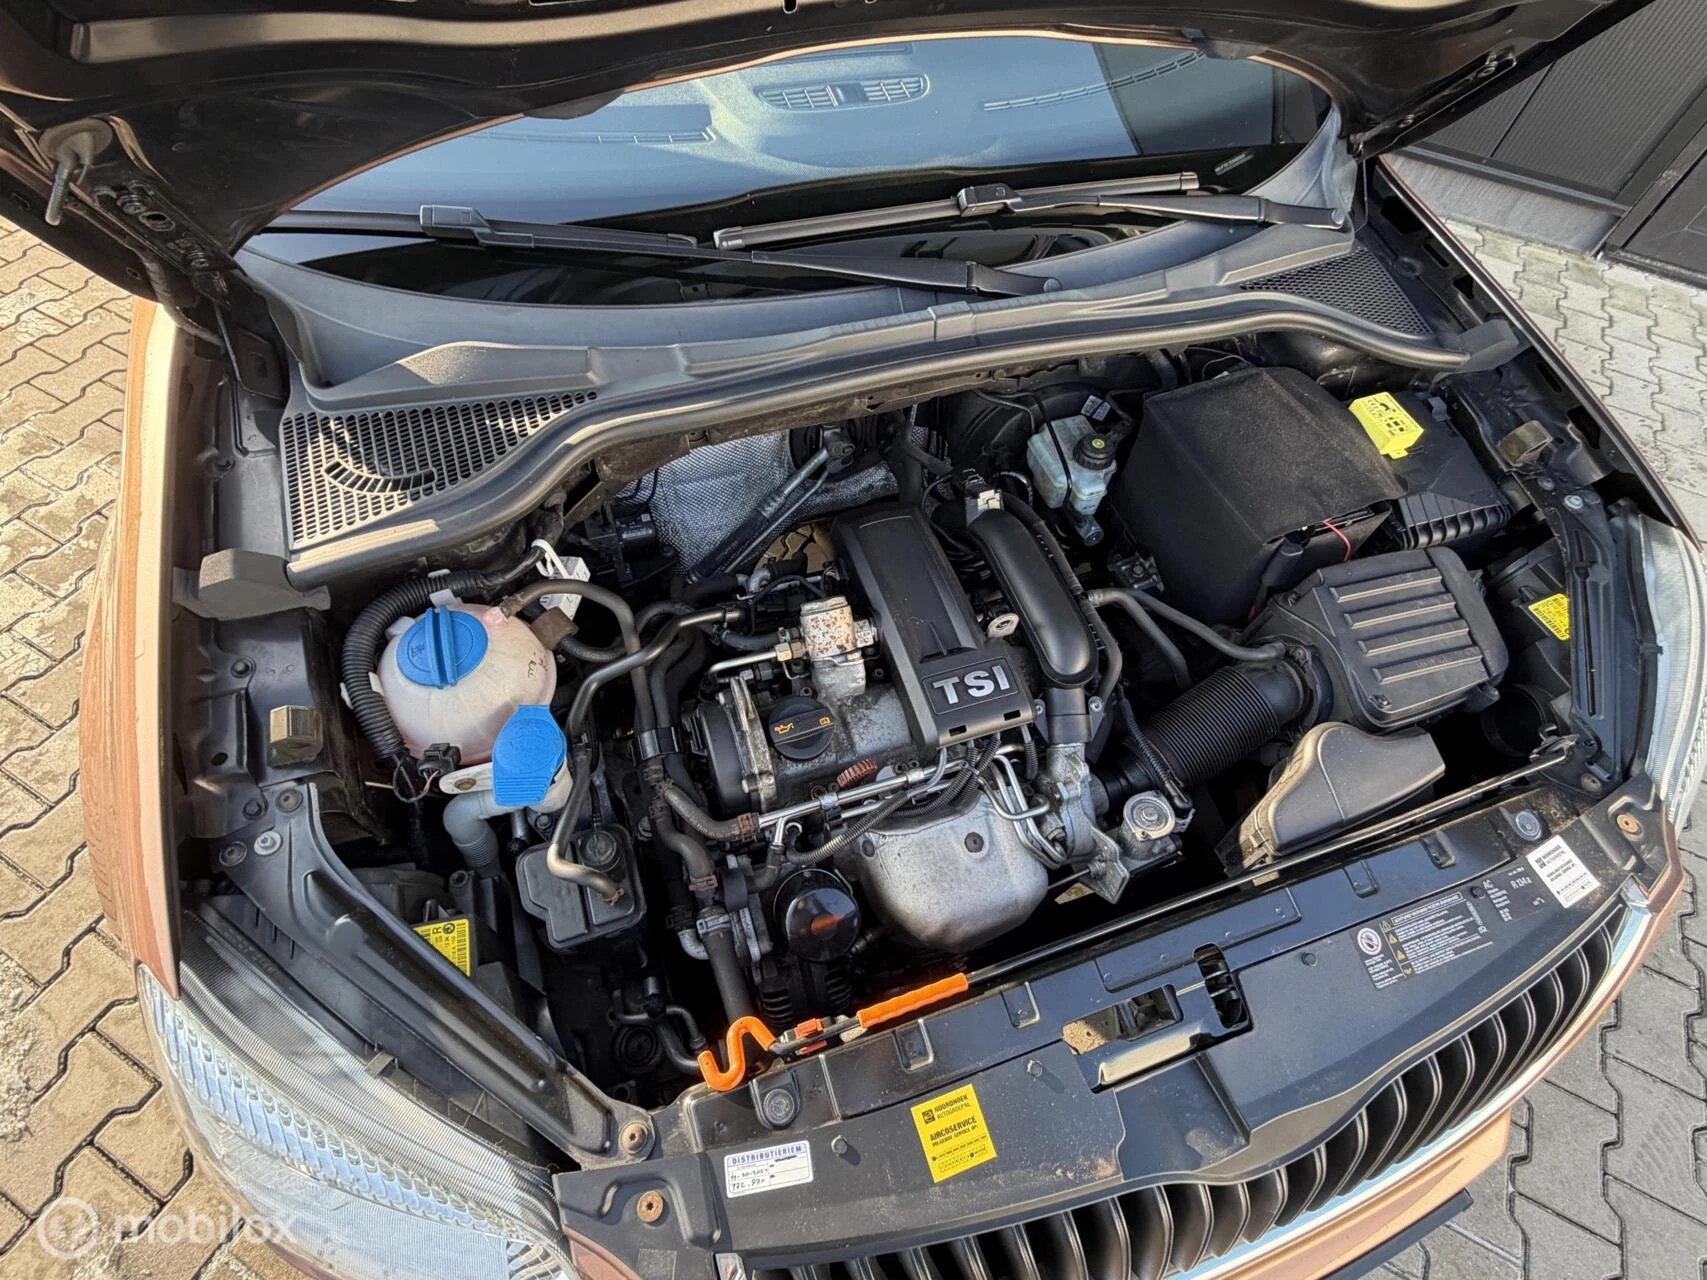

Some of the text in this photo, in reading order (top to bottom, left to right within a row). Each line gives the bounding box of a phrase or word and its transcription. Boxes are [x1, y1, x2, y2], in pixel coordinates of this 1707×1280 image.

[932, 665, 1010, 705] TSI
[1482, 879, 1494, 890] AC
[930, 1116, 977, 1141] AIRCOSERVICE
